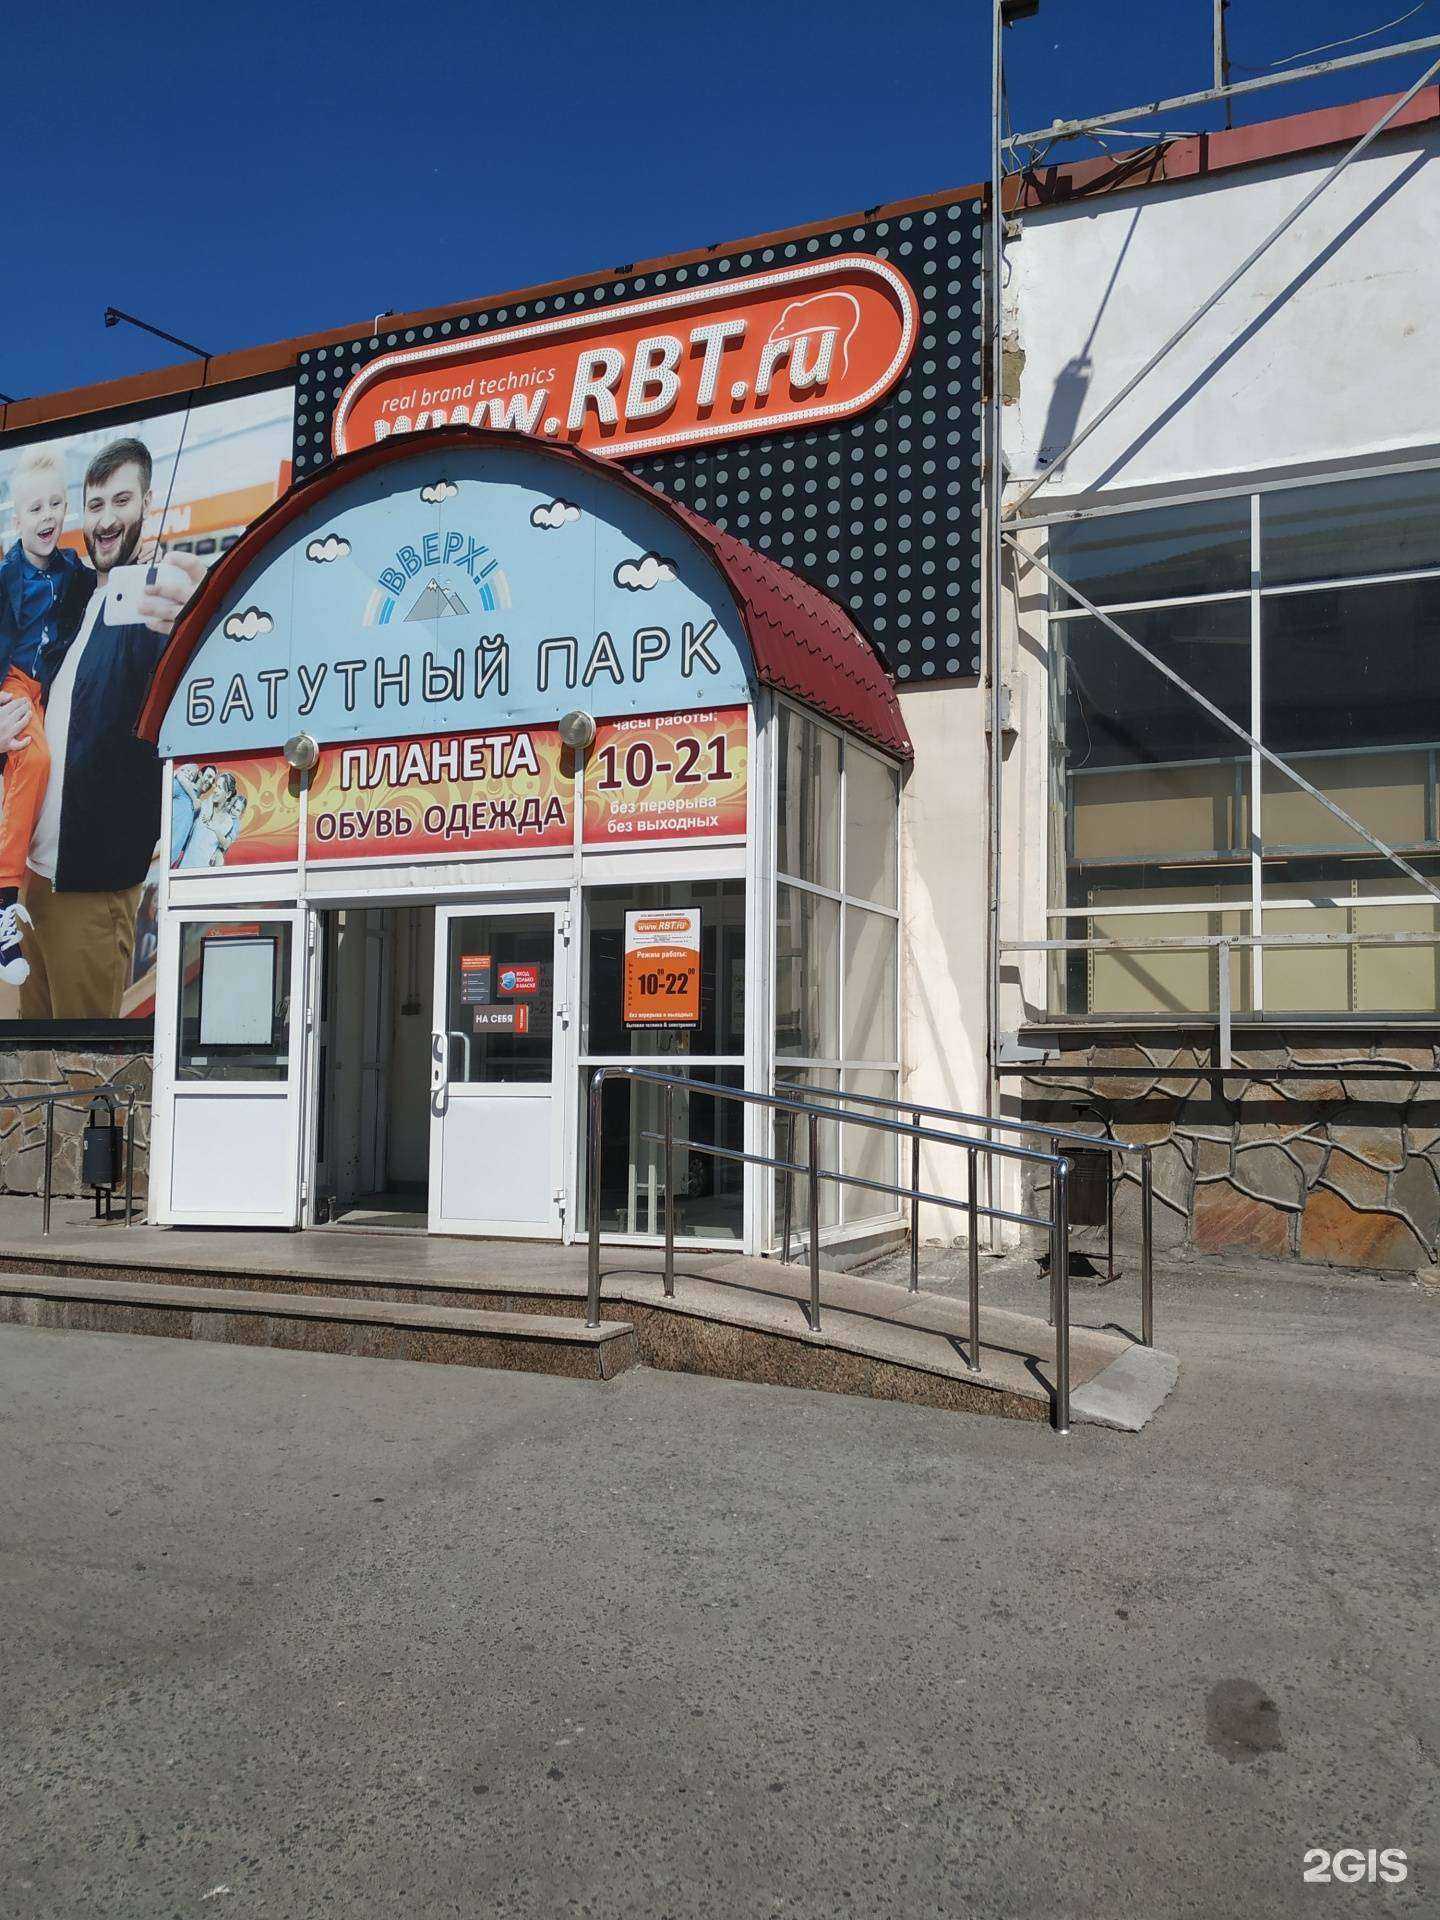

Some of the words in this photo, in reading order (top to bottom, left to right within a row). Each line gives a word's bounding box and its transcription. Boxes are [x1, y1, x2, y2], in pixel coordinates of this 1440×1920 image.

[381, 390, 416, 413] real
[421, 379, 474, 406] brand
[479, 366, 556, 396] technics
[378, 531, 498, 596] ВВЕРХ!
[186, 634, 510, 727] БАТУТНЫЙ
[536, 618, 723, 693] ПАРК
[613, 718, 651, 731] часы
[655, 711, 718, 729] работы:
[340, 731, 540, 791] ПЛАНЕТА
[598, 734, 733, 791] 10-21
[315, 802, 414, 842] ОБУВЬ
[423, 796, 567, 840] ОДЕЖДА
[608, 819, 633, 833] без
[637, 815, 719, 831] выходных
[610, 801, 636, 815] без
[640, 797, 717, 814] перерыва
[475, 1014, 489, 1023] НА
[490, 1014, 513, 1023] СЕБЯ
